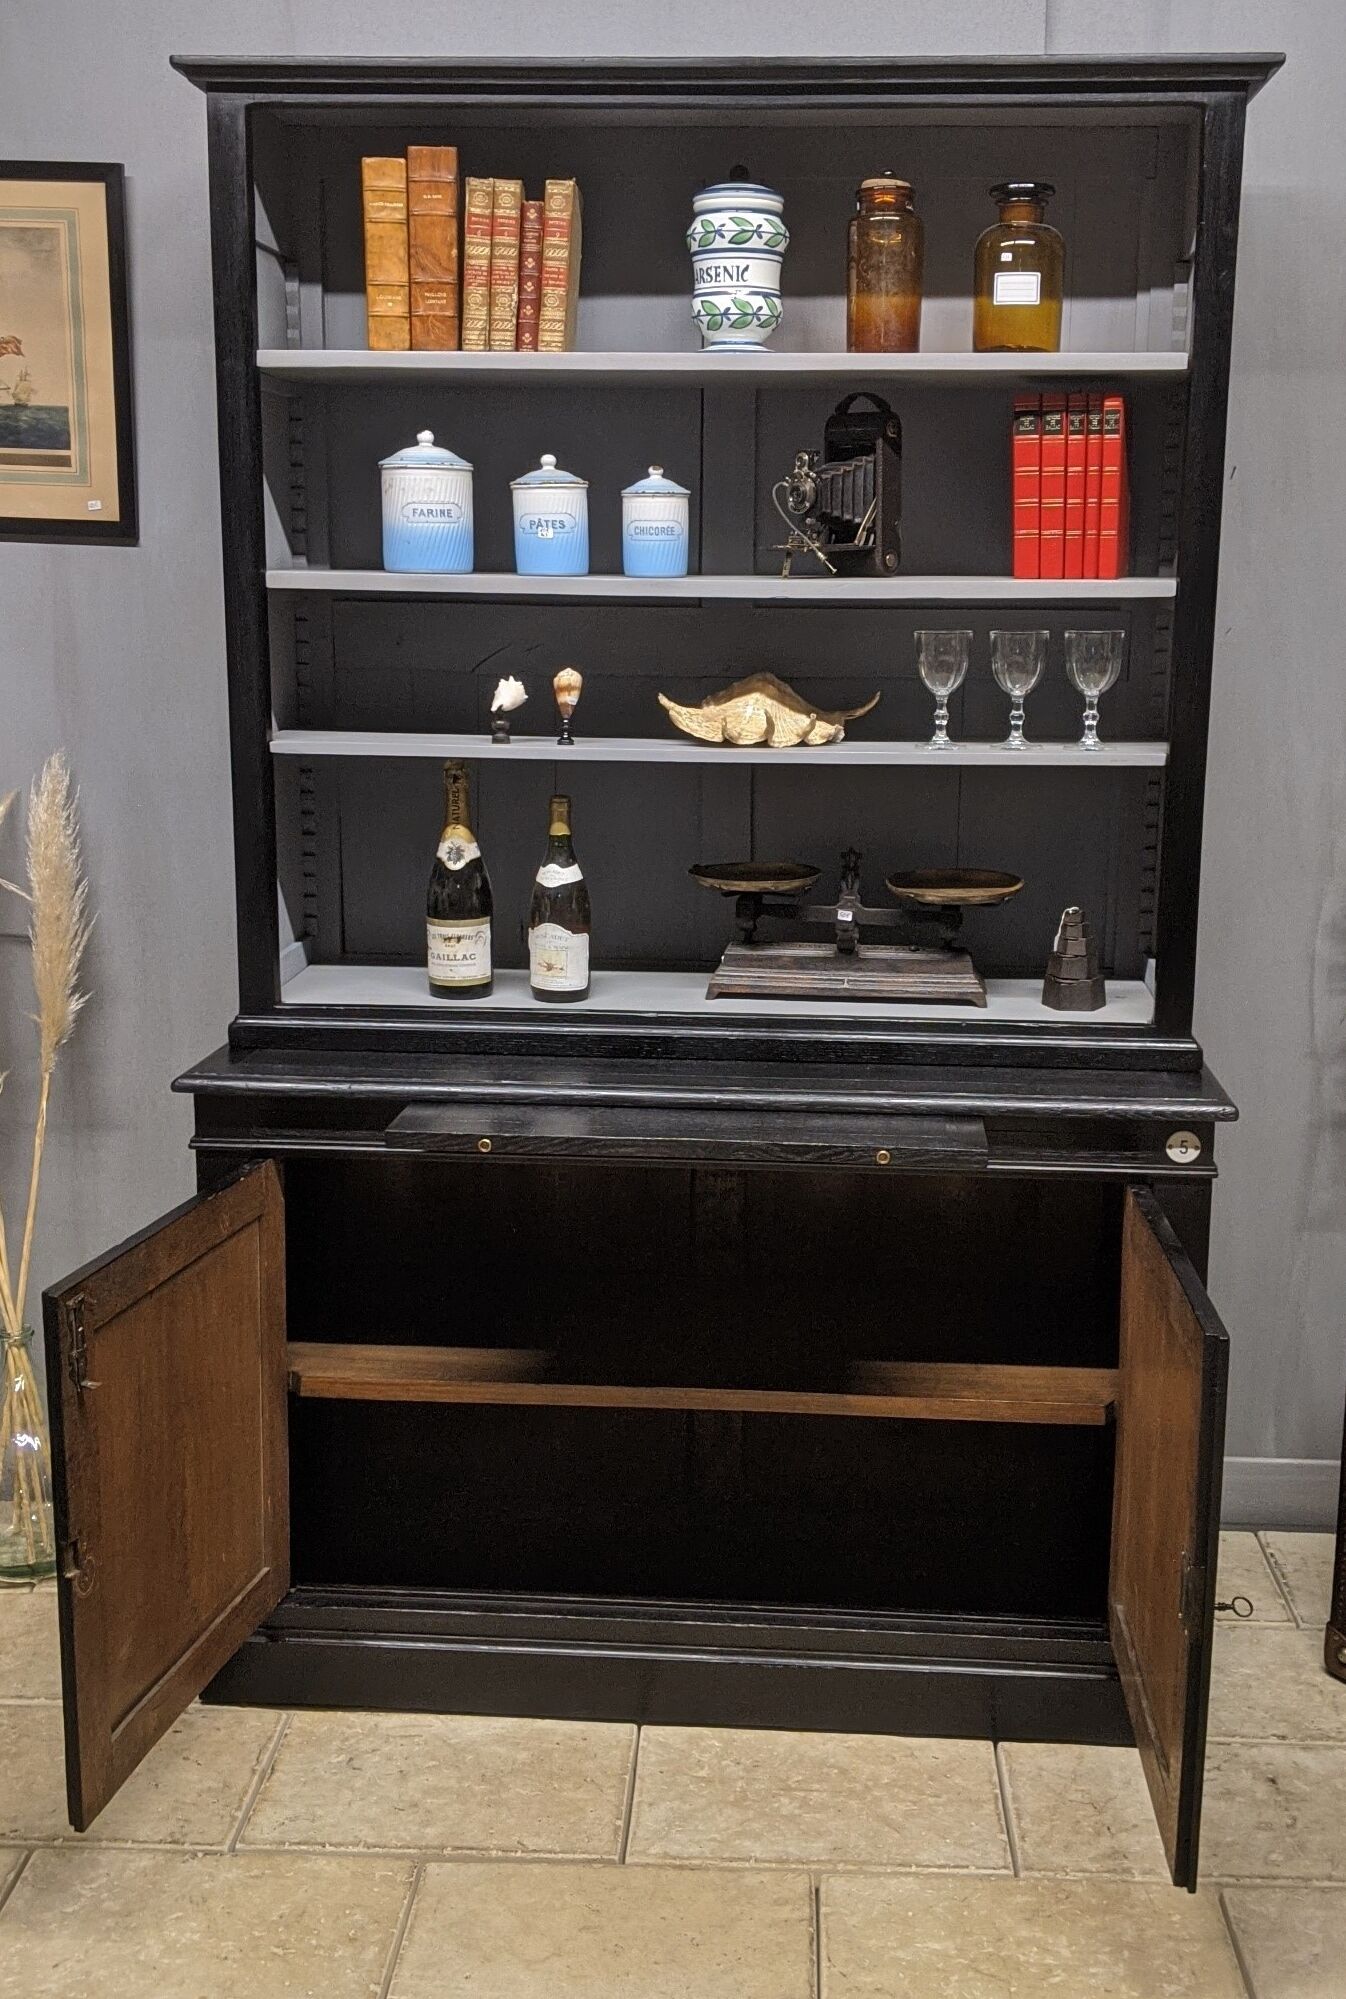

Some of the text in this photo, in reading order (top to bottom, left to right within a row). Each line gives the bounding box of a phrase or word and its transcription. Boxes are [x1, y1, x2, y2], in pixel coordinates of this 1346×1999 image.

[695, 264, 750, 284] ARSENIC
[412, 508, 453, 518] FARINE
[529, 518, 566, 529] PÂTES
[634, 526, 676, 536] CHICORÉE
[451, 788, 461, 830] NATUREL
[430, 952, 477, 961] GAILLAC
[1179, 1139, 1189, 1154] 5
